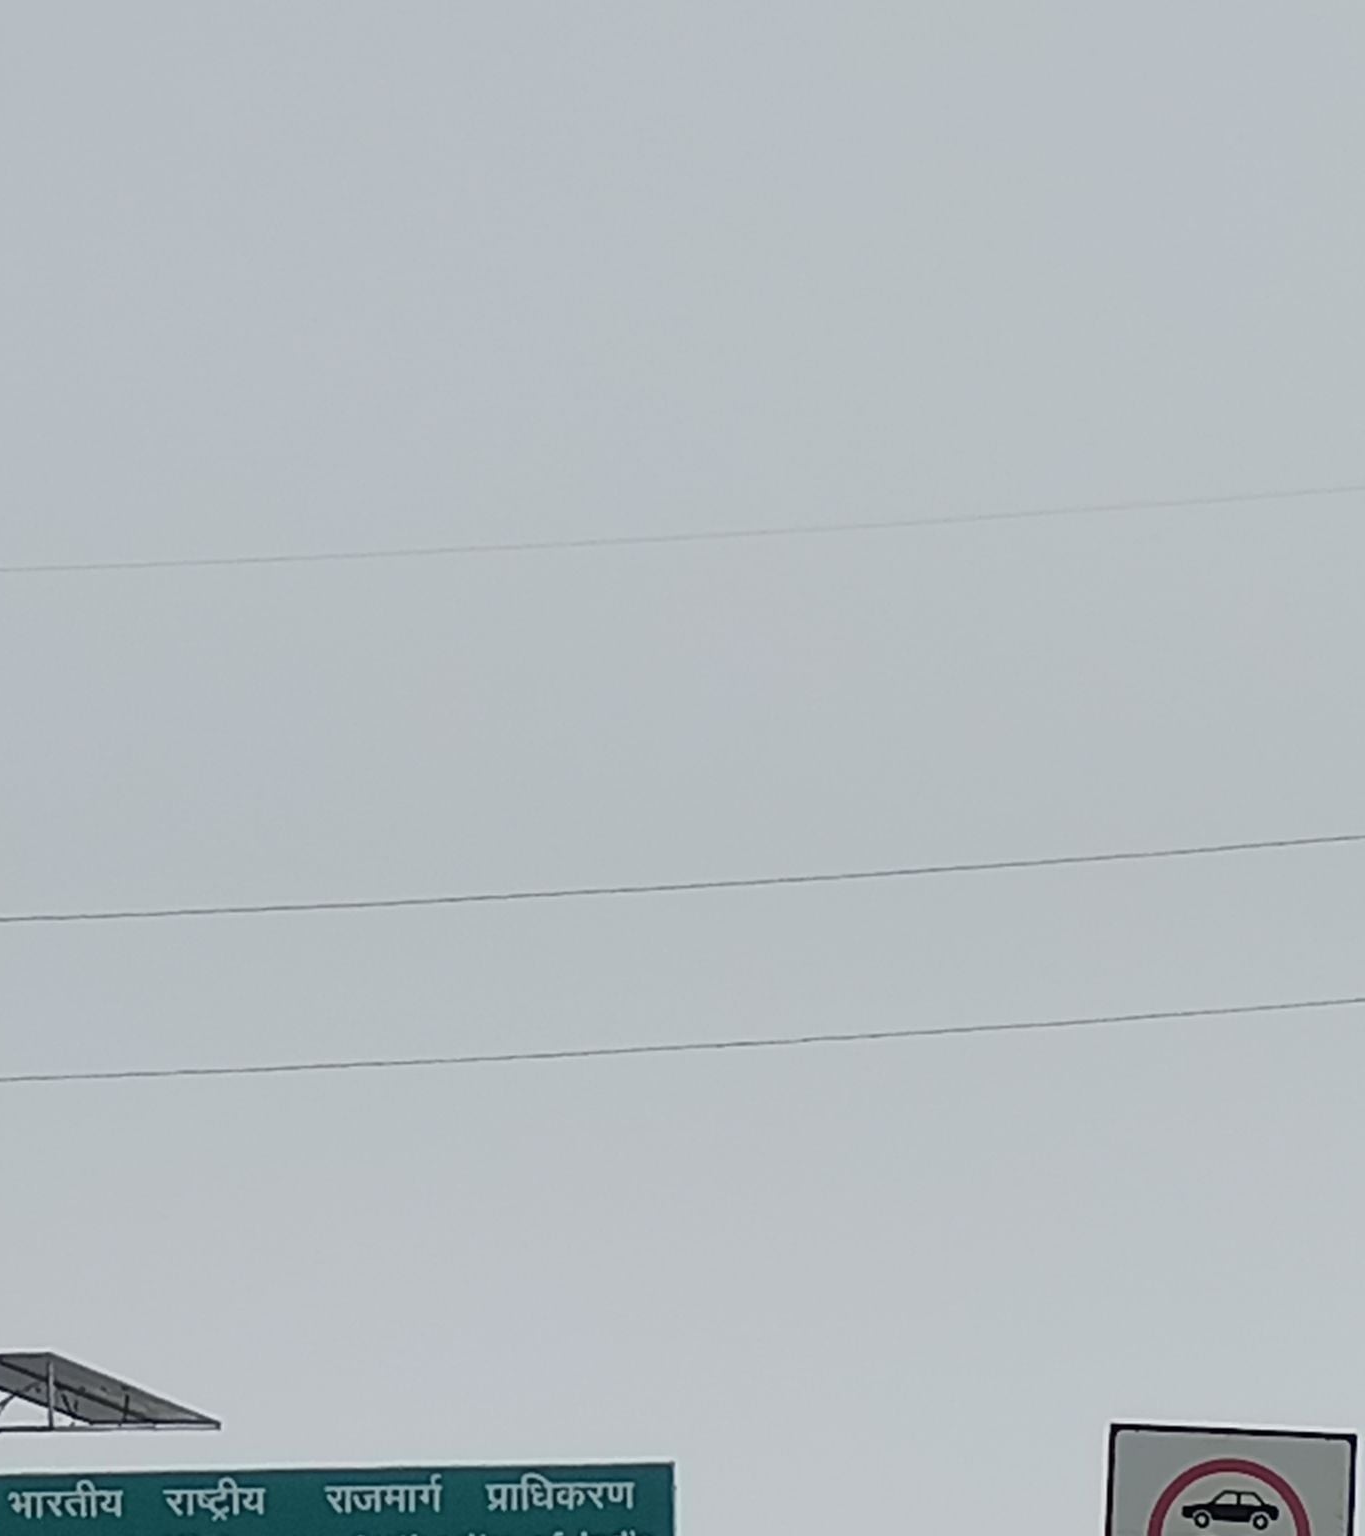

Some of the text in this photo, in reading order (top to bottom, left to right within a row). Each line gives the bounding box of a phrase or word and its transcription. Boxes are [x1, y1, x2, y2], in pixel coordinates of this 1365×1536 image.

[7, 1471, 635, 1522] भारतीय राष्ट्रीय राजमार्ग प्राधिकरण
